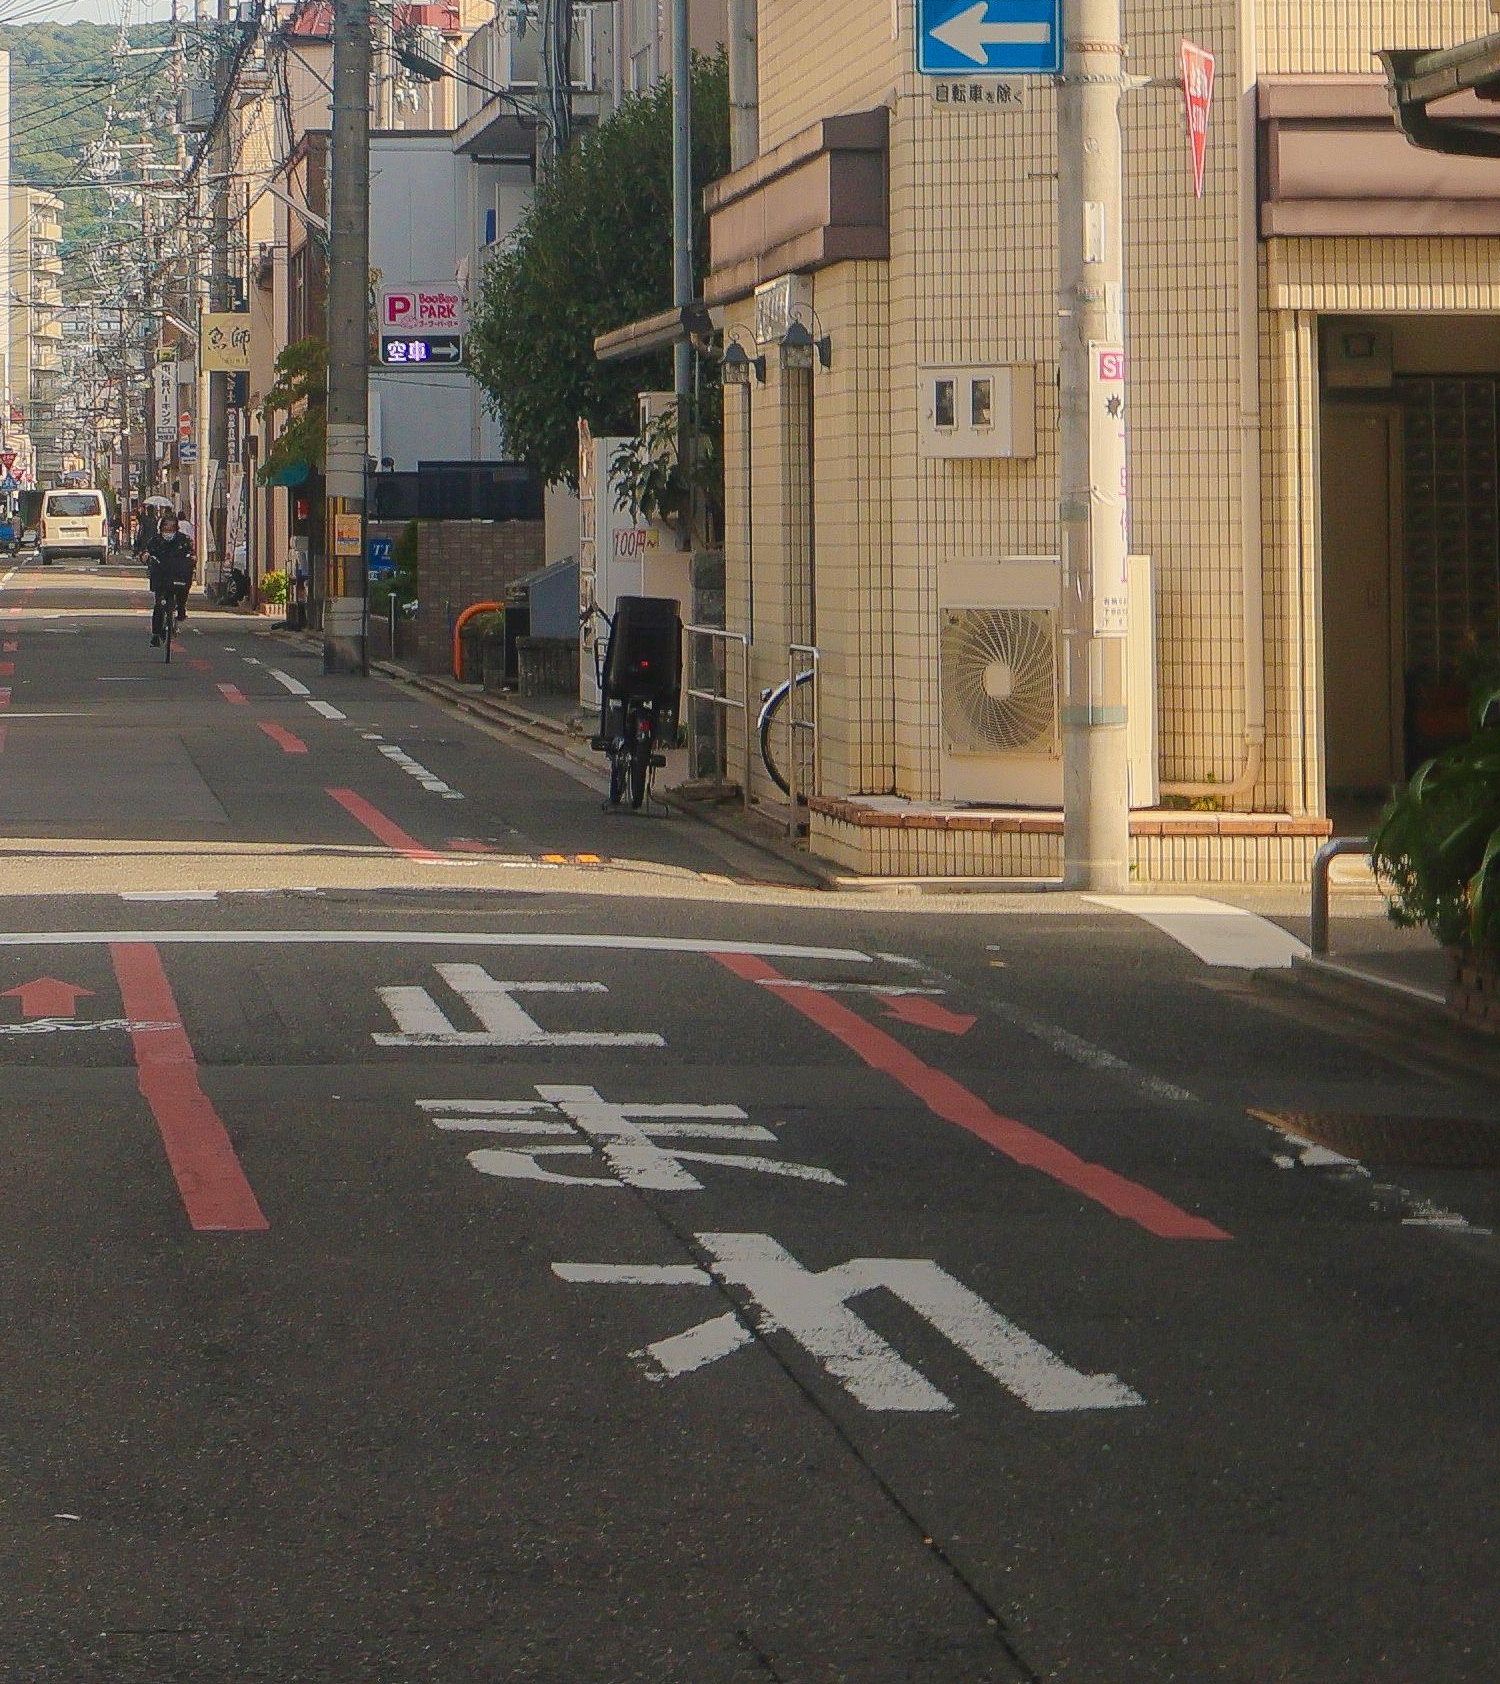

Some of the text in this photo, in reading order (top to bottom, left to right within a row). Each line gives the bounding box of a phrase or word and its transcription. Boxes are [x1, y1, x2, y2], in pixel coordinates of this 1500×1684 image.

[388, 297, 411, 322] P
[420, 305, 456, 318] PARK
[387, 340, 427, 362] 空車
[370, 962, 1146, 1412] 止まれ
